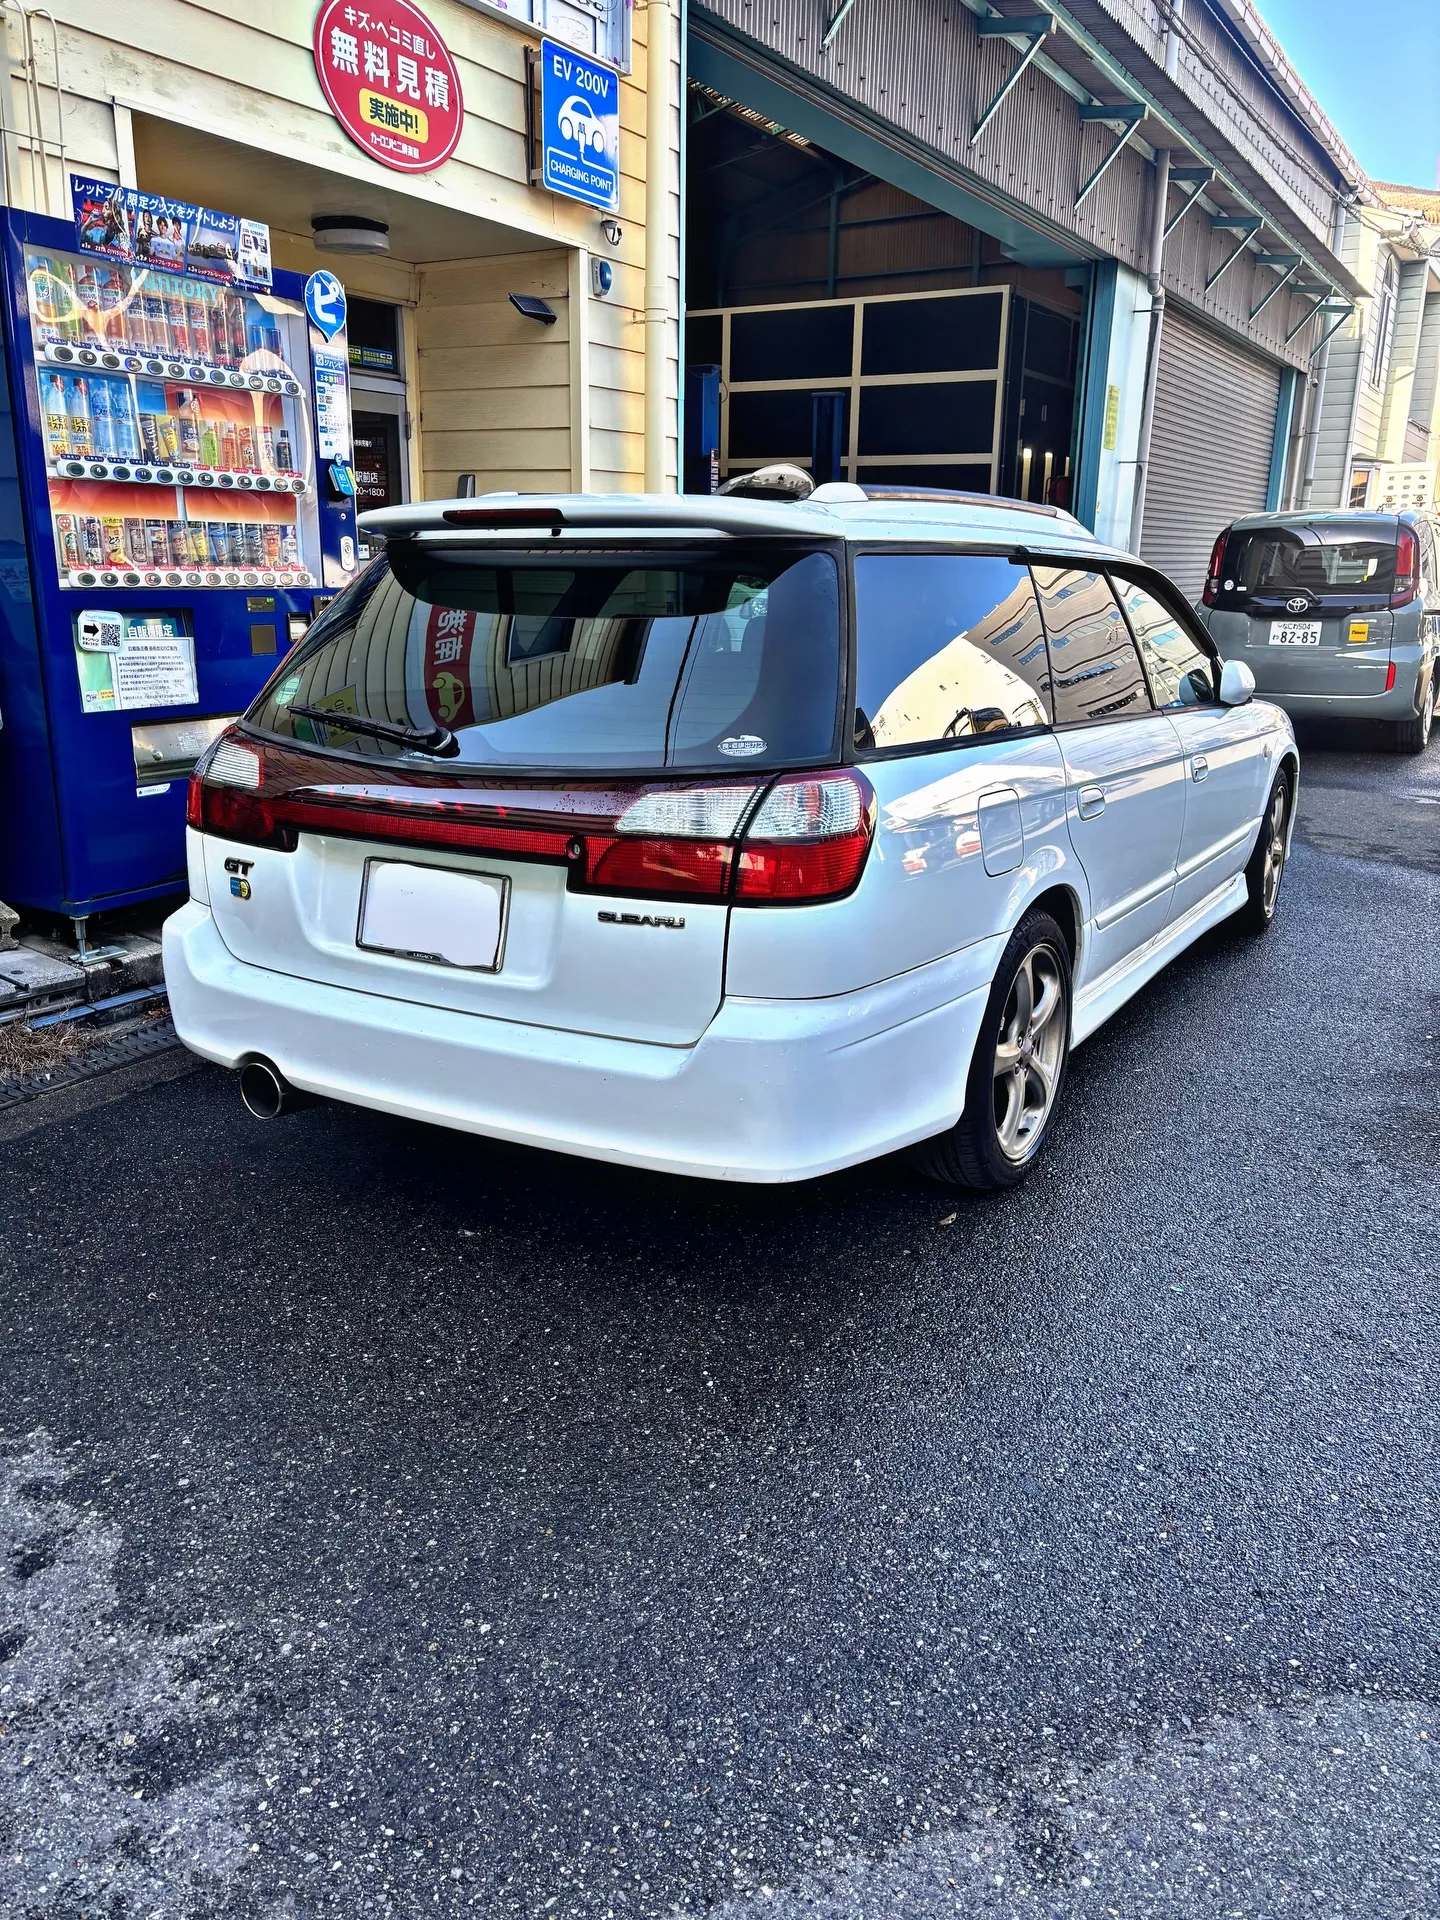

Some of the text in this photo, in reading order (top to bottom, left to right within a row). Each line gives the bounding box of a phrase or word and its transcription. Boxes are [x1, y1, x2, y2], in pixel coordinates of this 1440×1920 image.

[344, 5, 436, 59] キズ・ヘコミ直し
[330, 26, 450, 112] 無料見積
[553, 55, 609, 98] EV 200V
[550, 159, 613, 192] CHARGING POINT
[127, 624, 174, 637] 自販機限定
[1280, 631, 1318, 644] 82-85
[224, 856, 255, 876] GT
[597, 909, 686, 930] SUBARU
[412, 952, 434, 960] LEGACY
